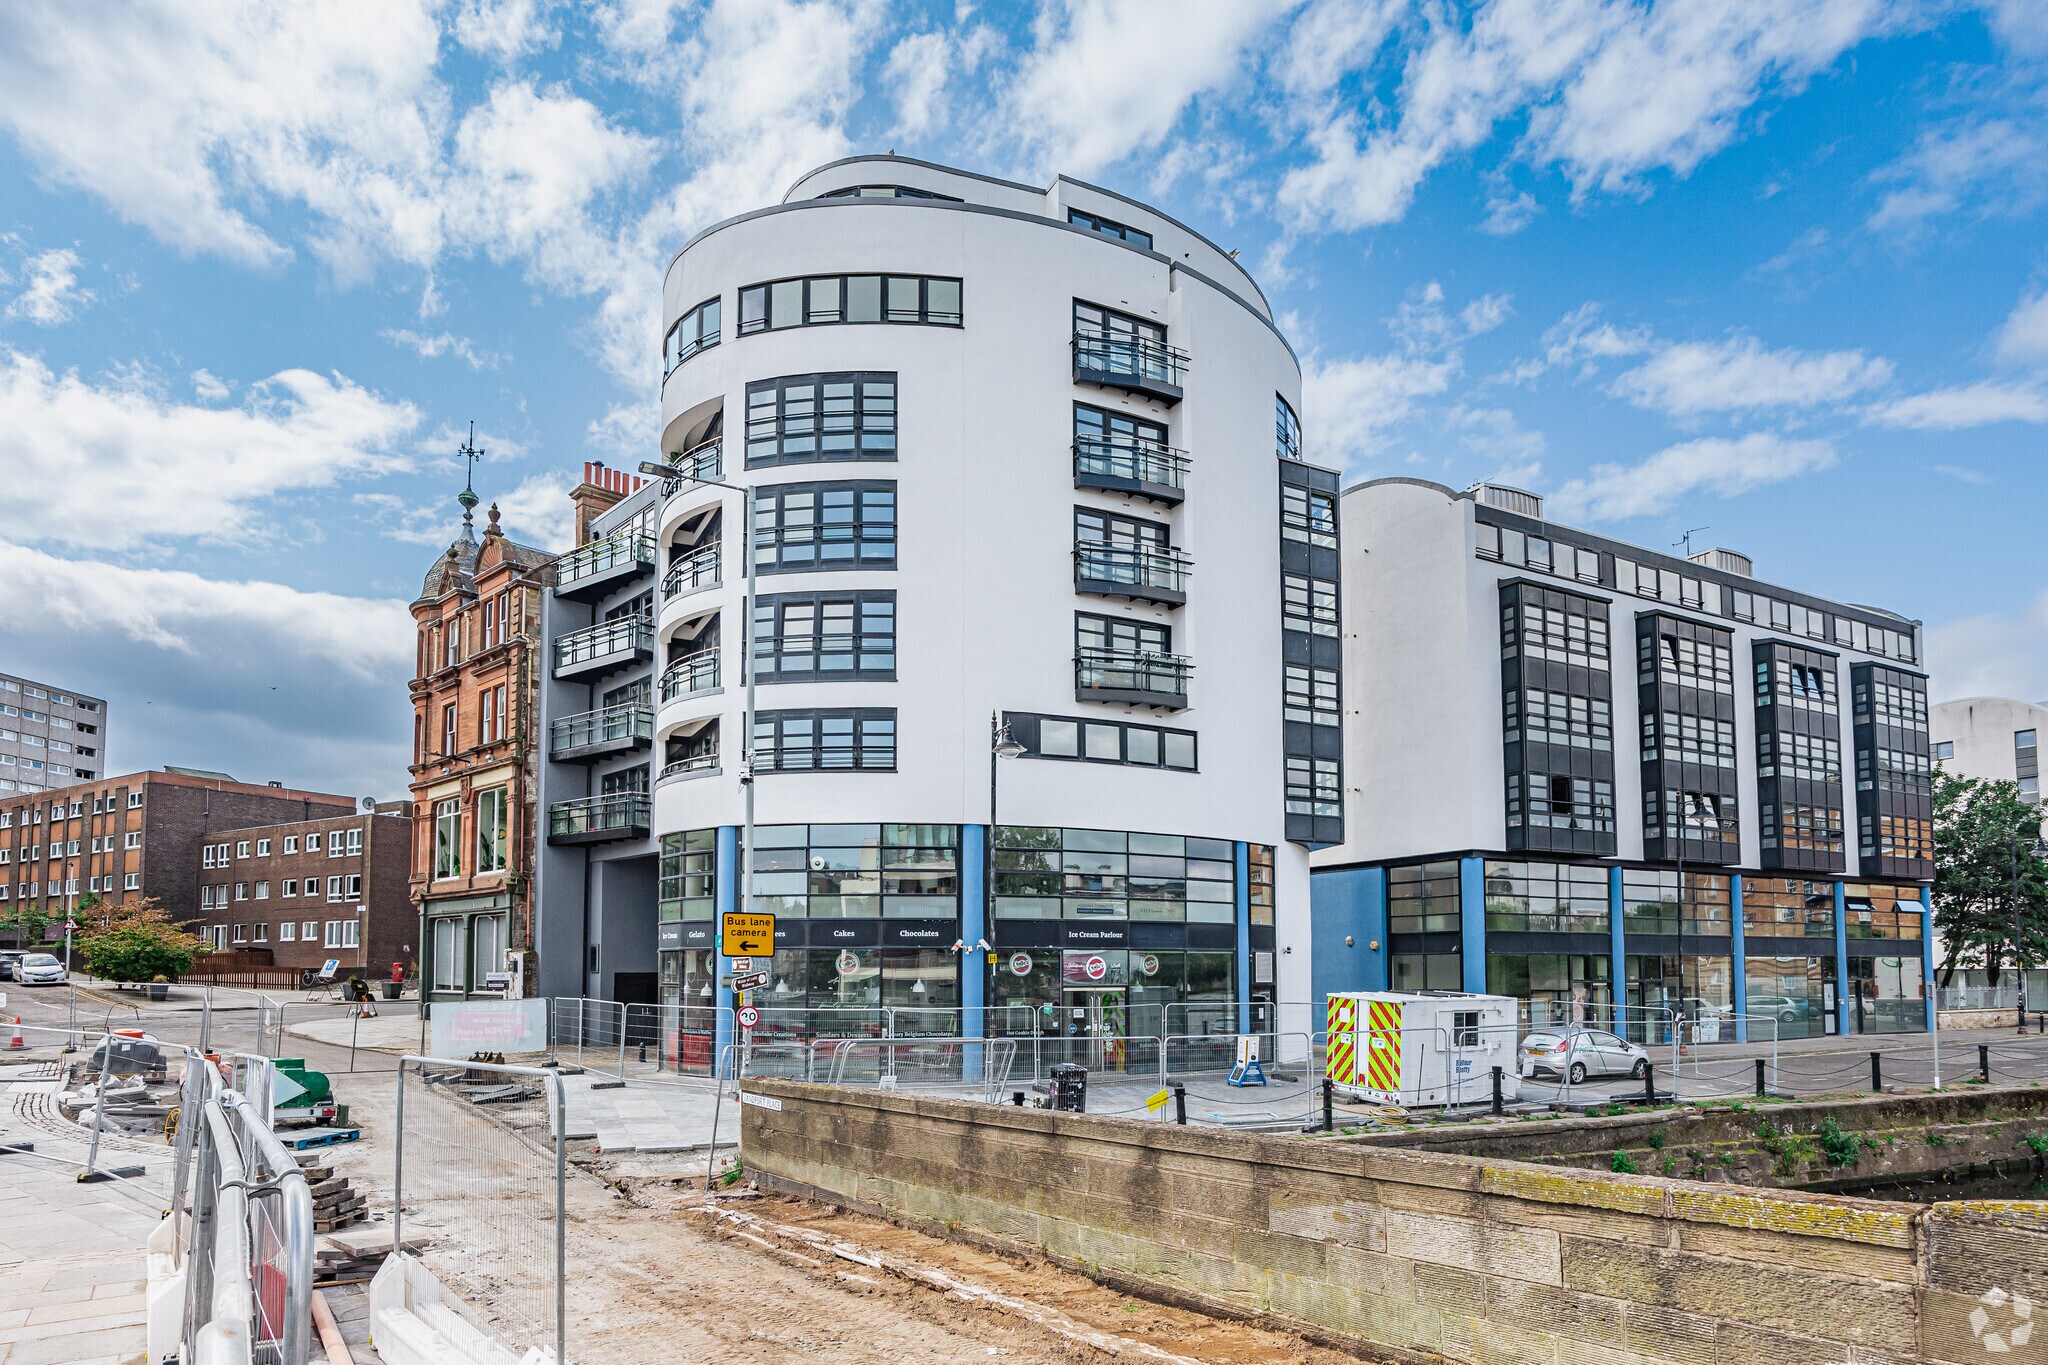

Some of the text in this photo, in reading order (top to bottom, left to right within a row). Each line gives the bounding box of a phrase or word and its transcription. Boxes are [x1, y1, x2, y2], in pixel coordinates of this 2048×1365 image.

[727, 916, 771, 927] Bus lane
[688, 930, 706, 938] Gelato
[730, 929, 767, 937] camera
[833, 929, 855, 937] Cakes
[899, 929, 939, 937] Chocolates
[990, 954, 995, 962] H
[1456, 1066, 1470, 1074] Beatty
